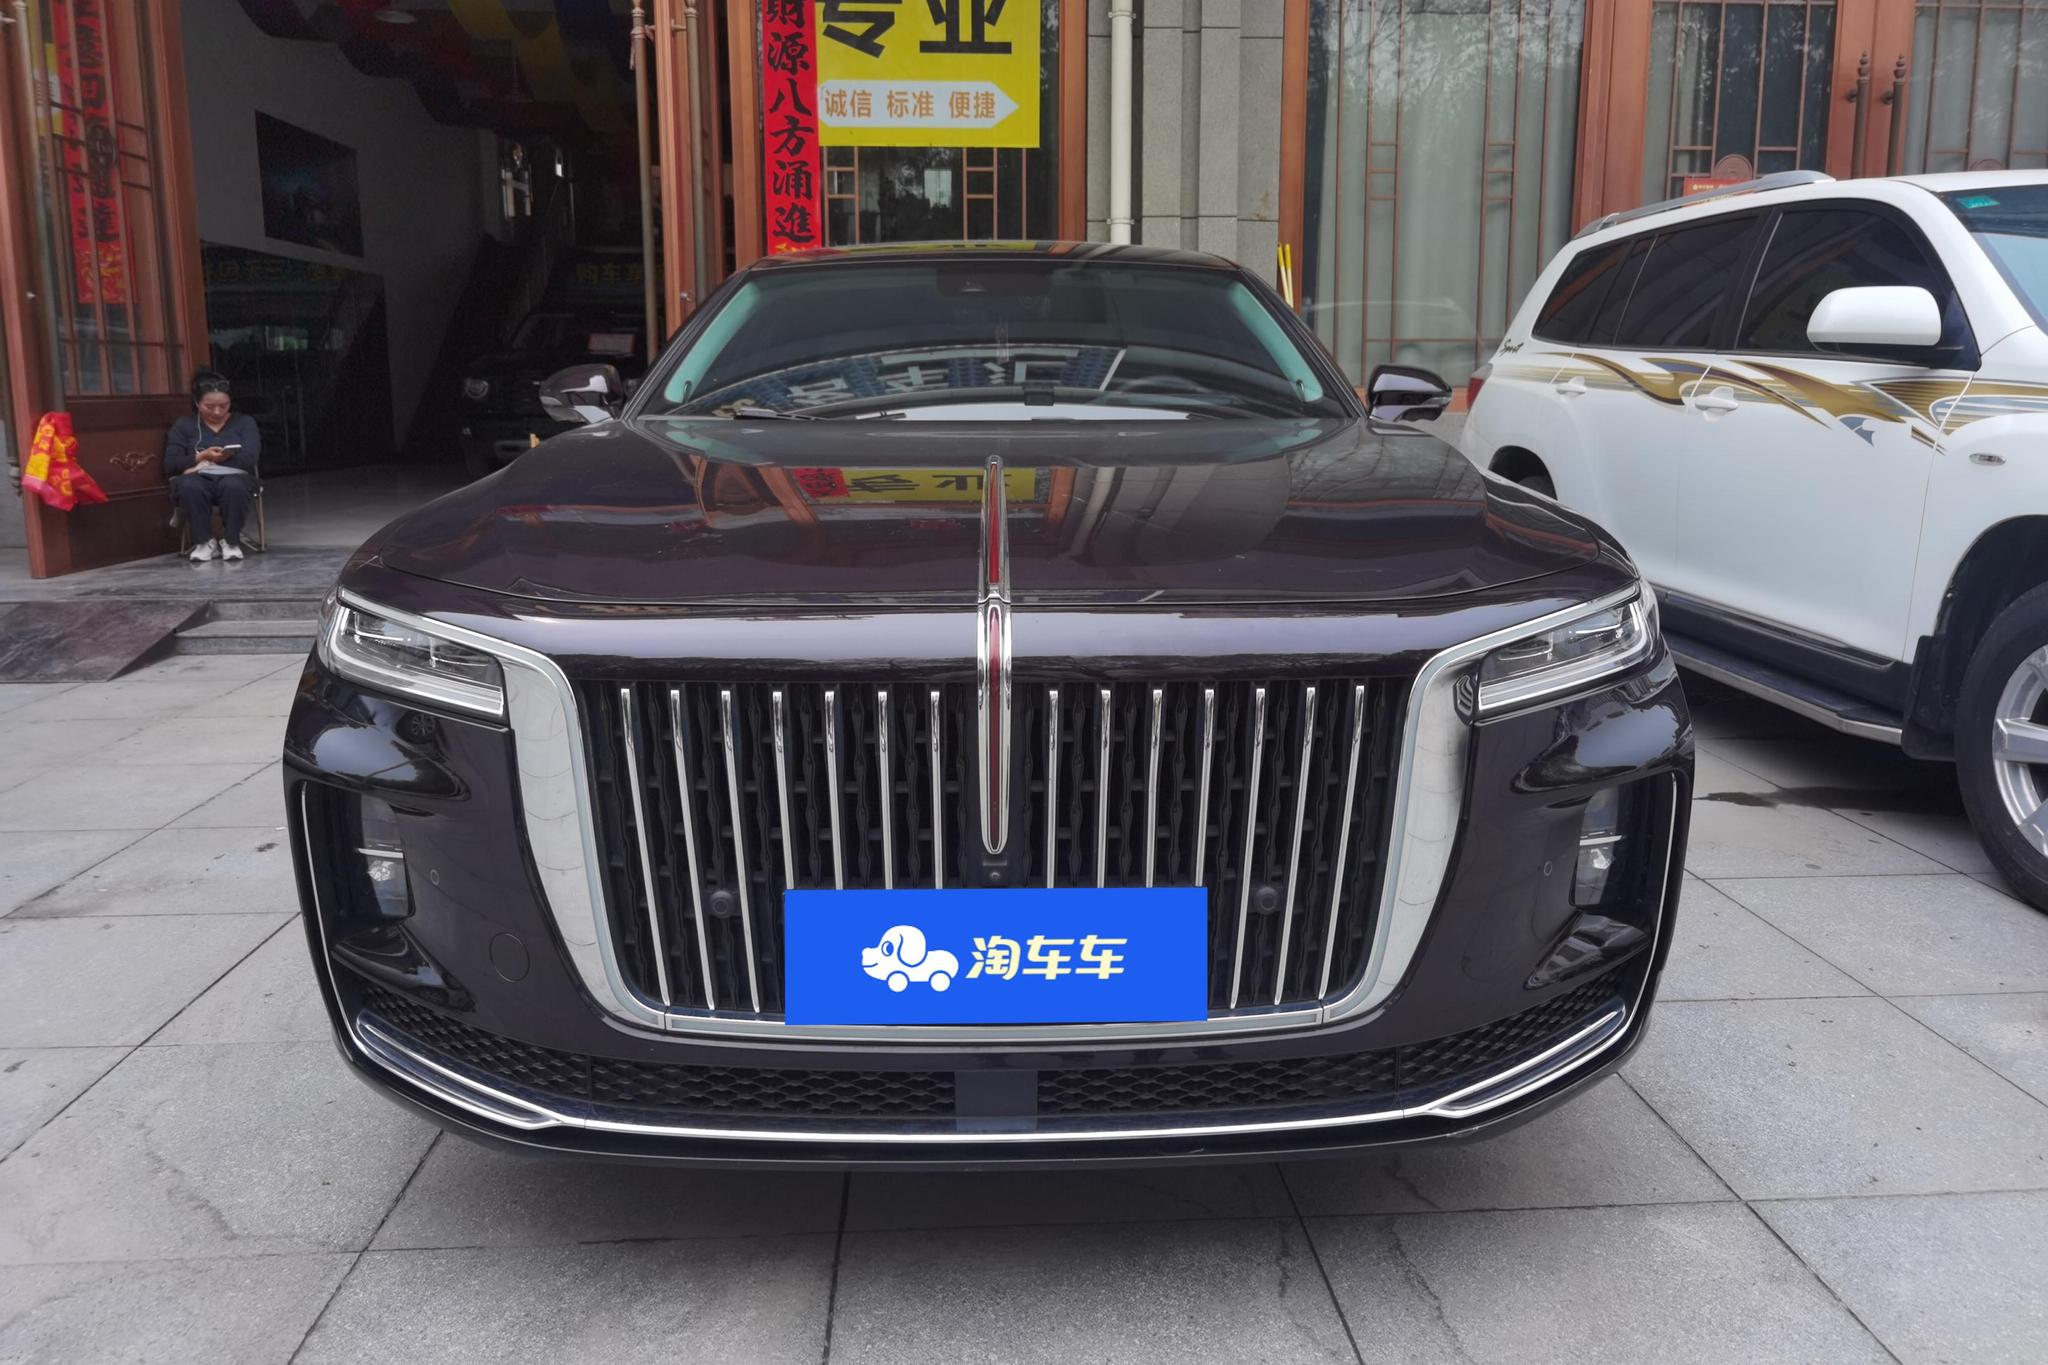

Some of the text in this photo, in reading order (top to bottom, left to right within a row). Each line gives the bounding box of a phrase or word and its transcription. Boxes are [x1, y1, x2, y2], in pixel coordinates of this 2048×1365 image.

[825, 89, 996, 119] 诚信 标准 便捷
